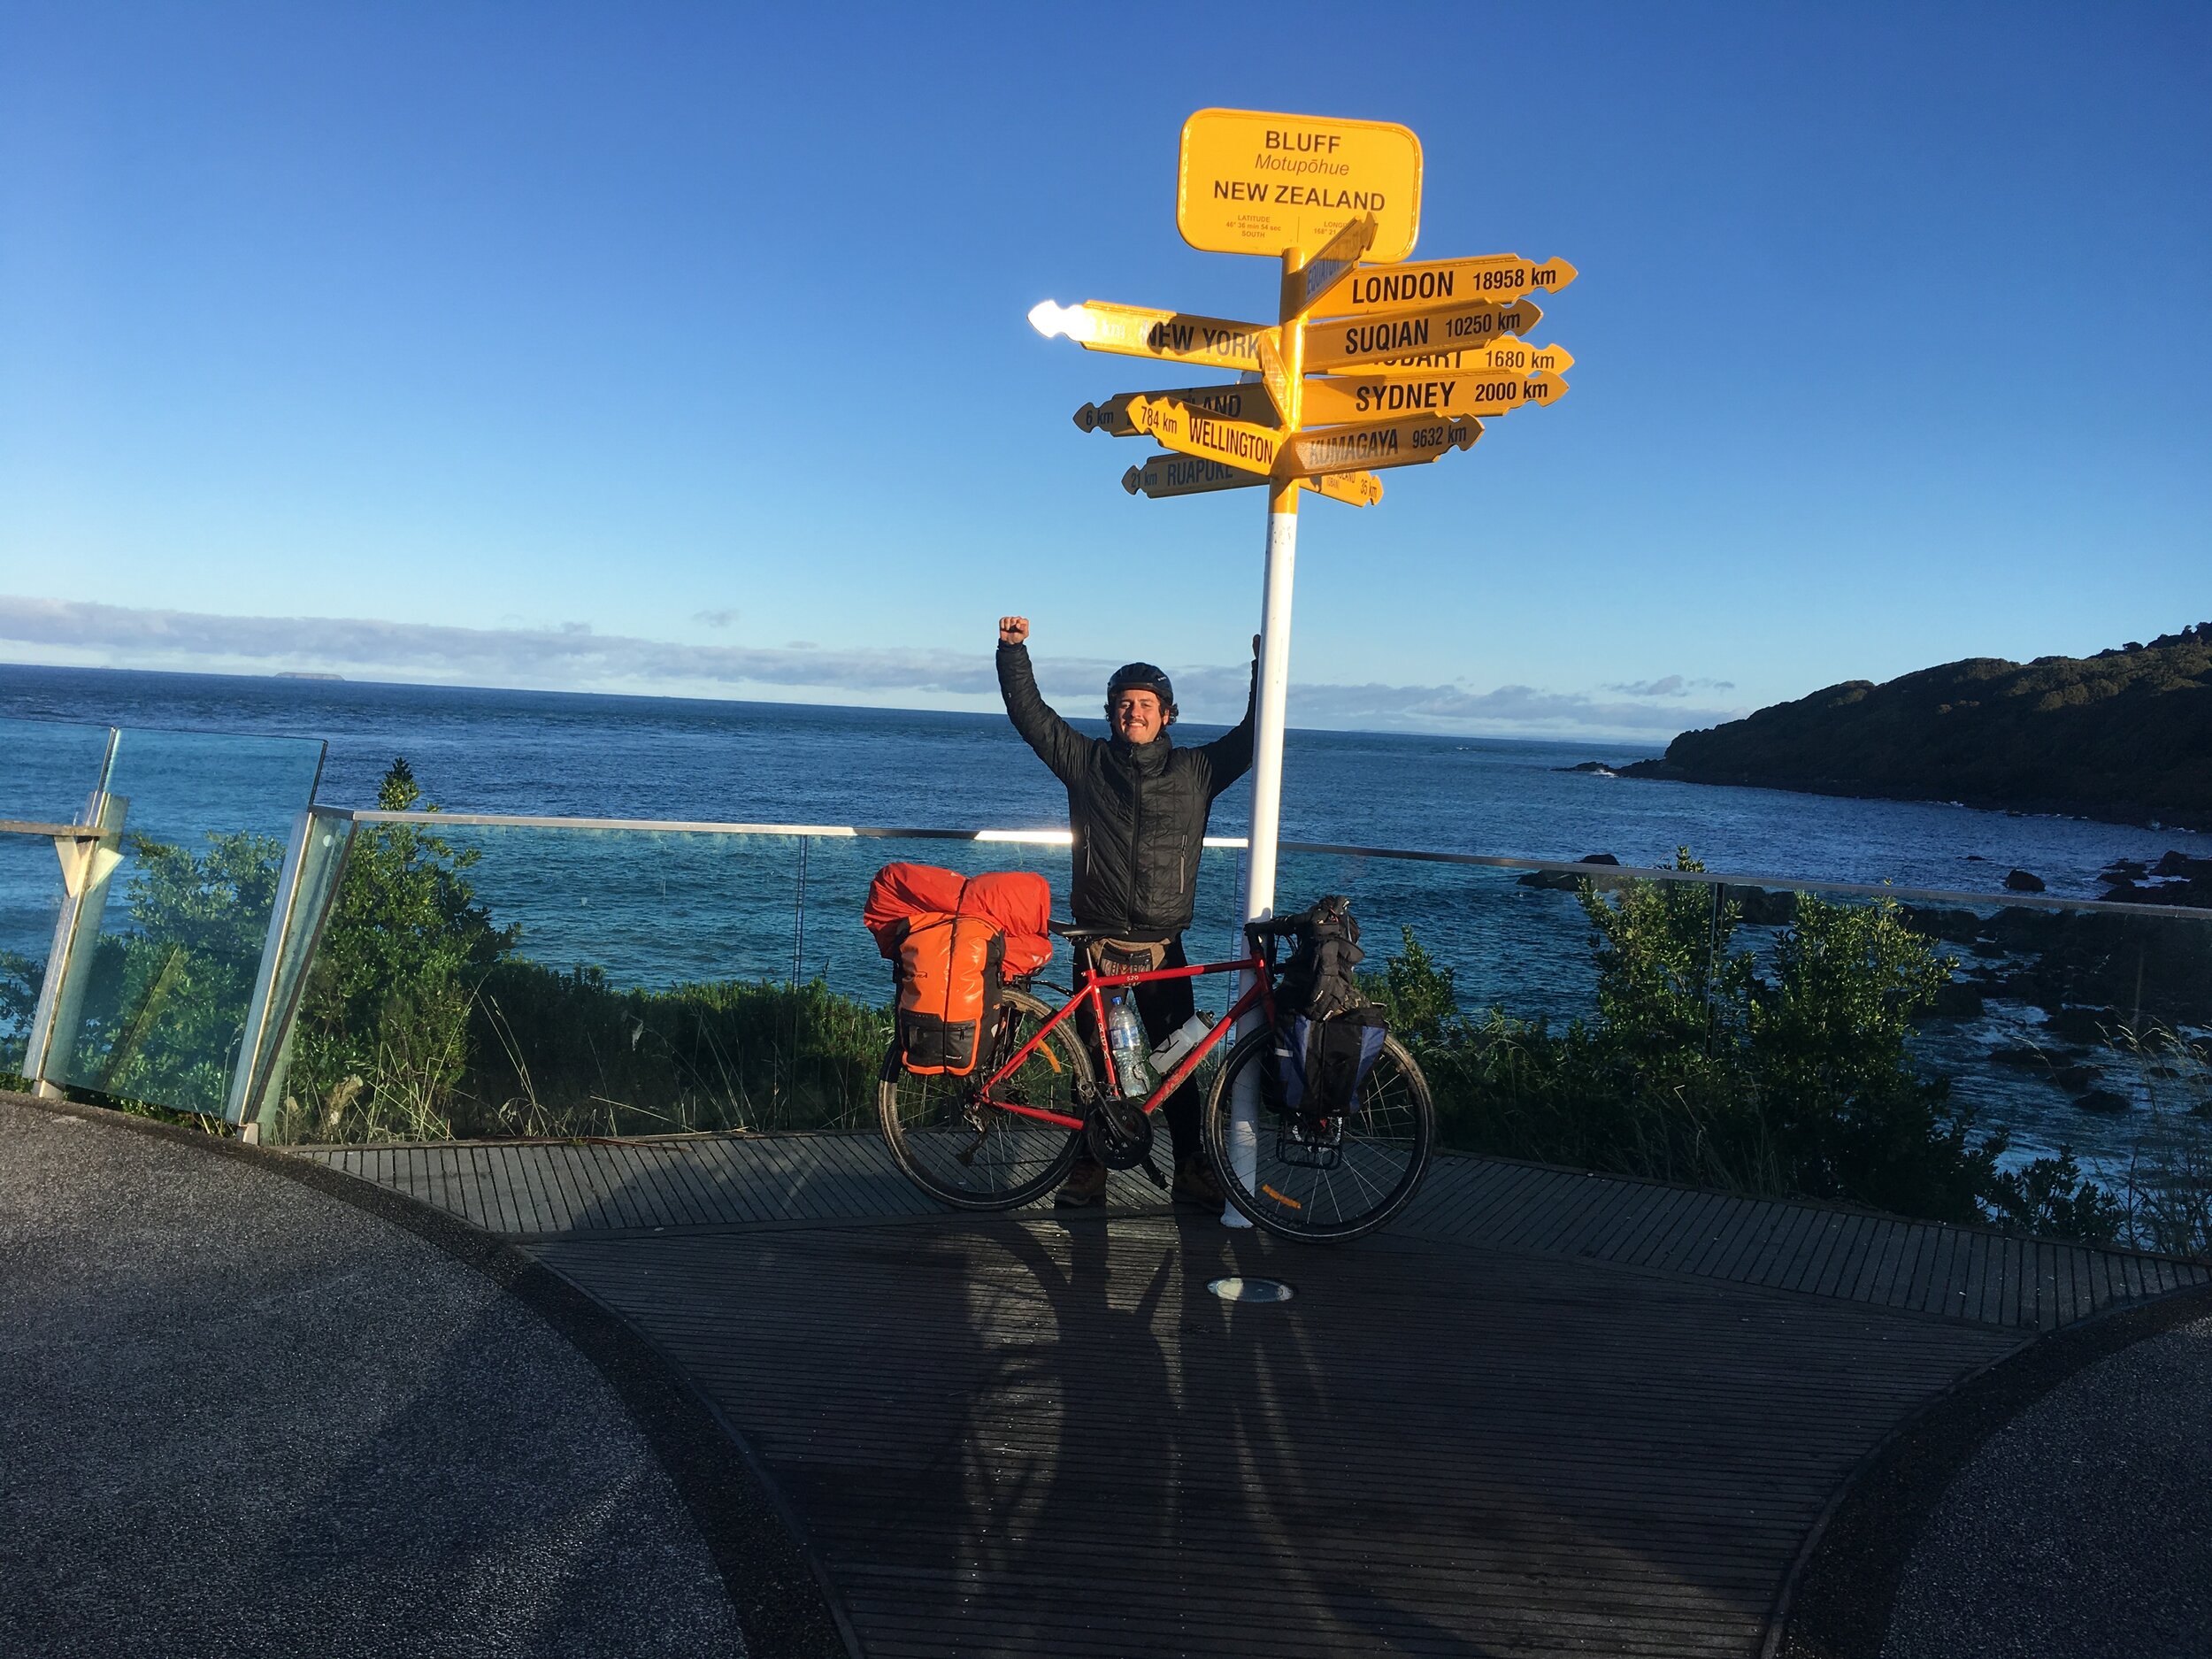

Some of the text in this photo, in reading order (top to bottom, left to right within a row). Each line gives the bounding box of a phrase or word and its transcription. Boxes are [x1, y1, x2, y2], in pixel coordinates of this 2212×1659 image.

[1265, 130, 1341, 154] BLUFF
[1255, 154, 1350, 176] Motupōhue
[1214, 180, 1386, 211] NEW ZEALAND
[1352, 267, 1556, 304] LONDON 18958 km
[1202, 326, 1260, 359] YORK
[1345, 311, 1521, 355] SUQIAN 10250 km
[1485, 350, 1525, 368] 1680
[1532, 351, 1555, 369] km
[1356, 380, 1548, 412] SYDNEY 2000 km
[1086, 410, 1094, 426] 6
[1097, 409, 1114, 425] km
[1141, 406, 1273, 465] 784 km WELLINGTON
[1310, 424, 1467, 465] KUMAGAYA 9632 km
[1144, 471, 1157, 486] km
[1360, 478, 1368, 495] 35
[1369, 481, 1378, 498] km
